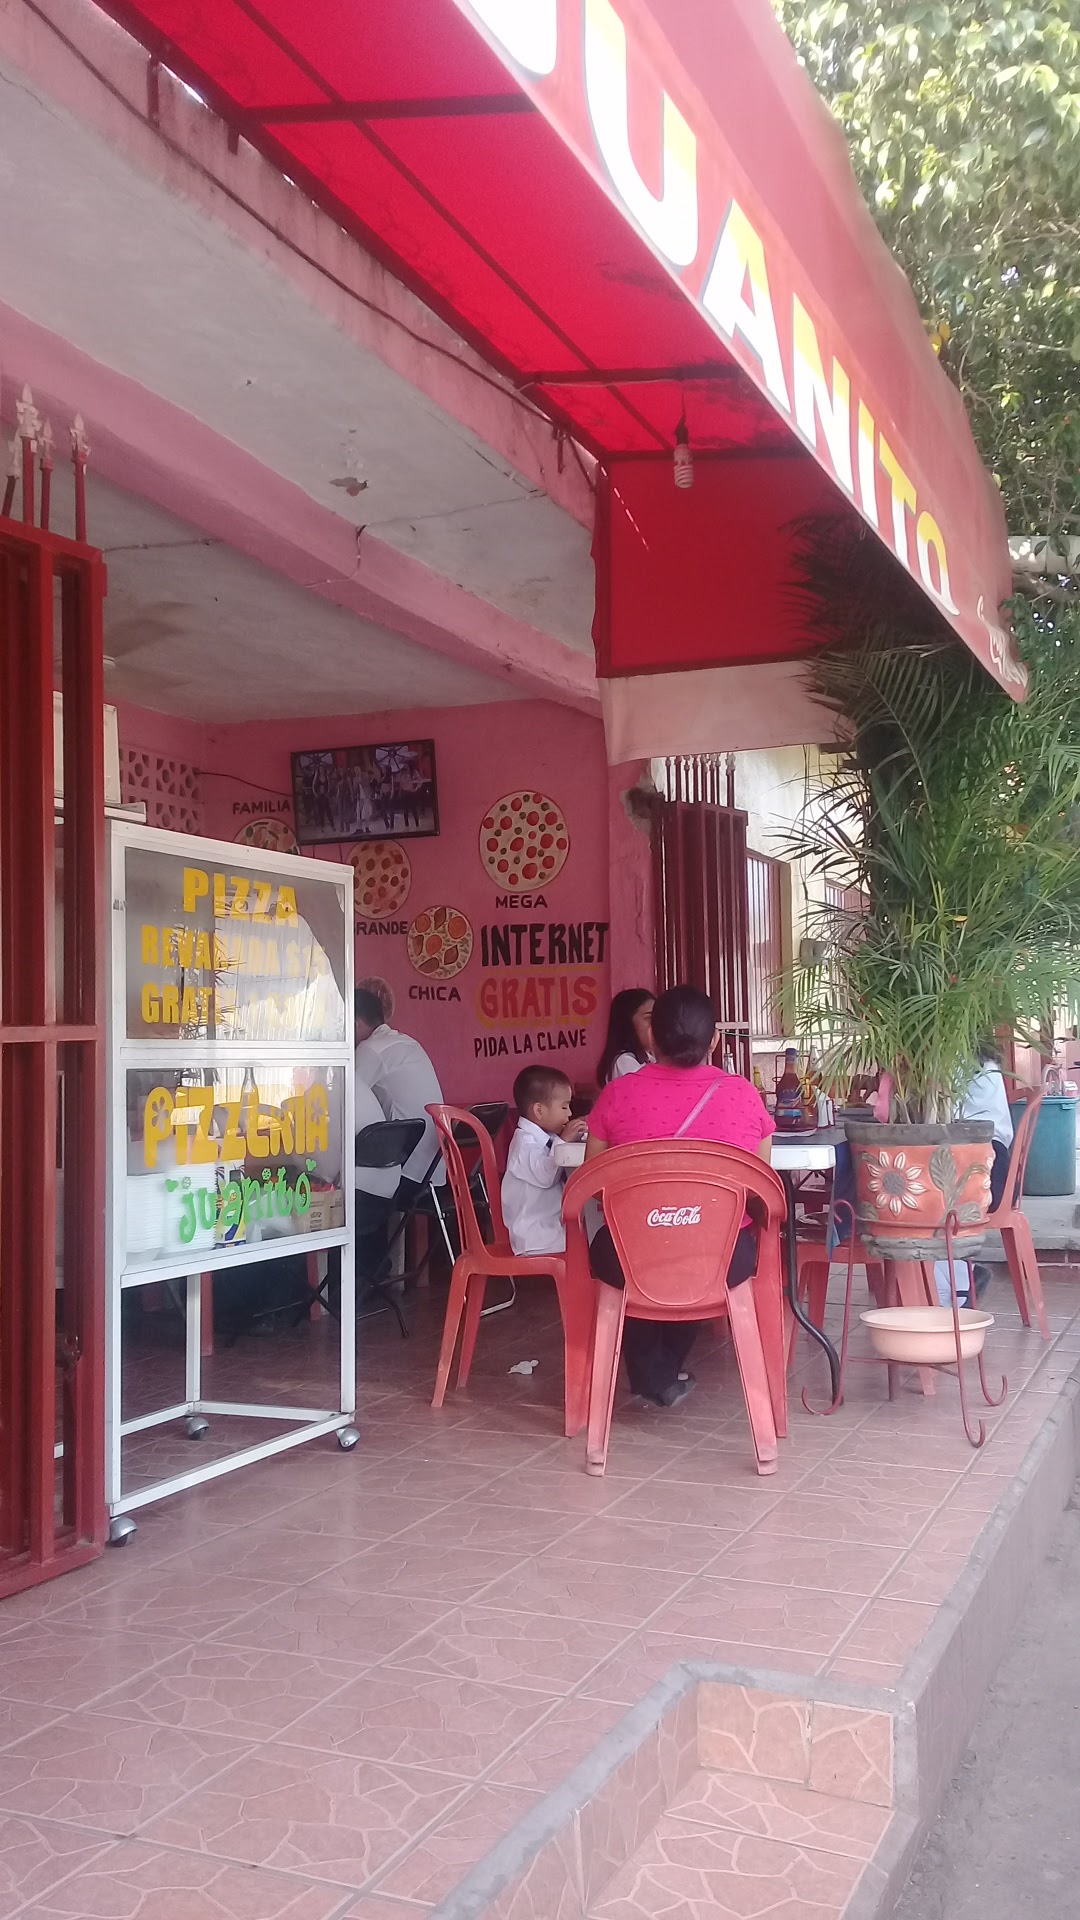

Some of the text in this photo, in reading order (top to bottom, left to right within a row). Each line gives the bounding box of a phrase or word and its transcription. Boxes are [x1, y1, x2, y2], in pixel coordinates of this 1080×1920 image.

[182, 866, 299, 929] PIZZA
[495, 894, 548, 909] MEGA
[354, 920, 408, 936] RANDE
[481, 921, 609, 967] INTERNET
[408, 985, 462, 1002] CHICA
[478, 975, 599, 1022] GRATIS
[474, 1028, 587, 1059] PIDA LA CLAVE
[143, 1082, 329, 1169] PIZZERIA
